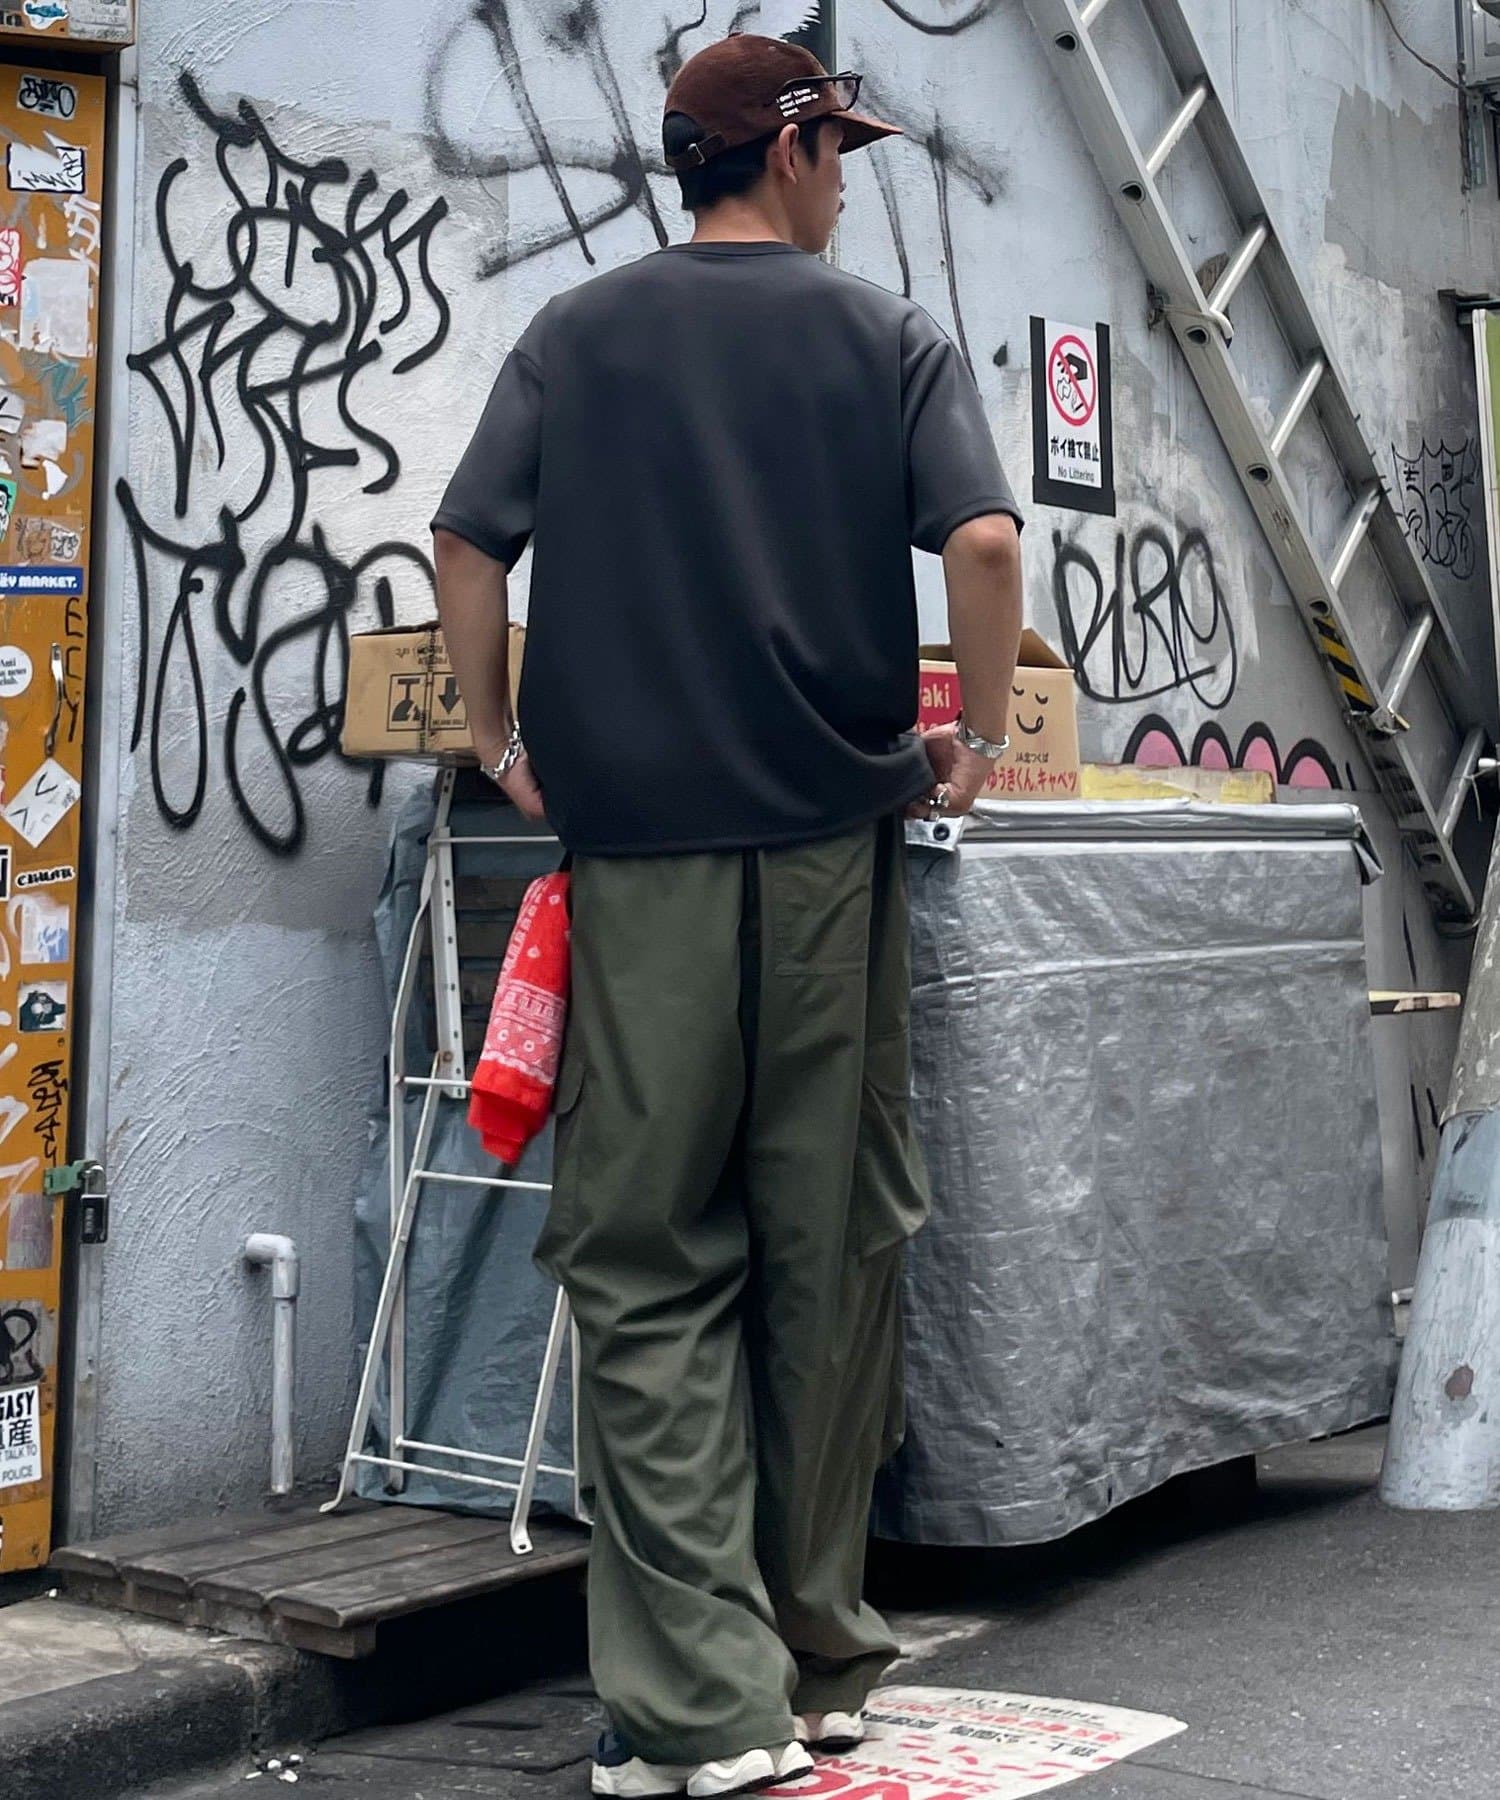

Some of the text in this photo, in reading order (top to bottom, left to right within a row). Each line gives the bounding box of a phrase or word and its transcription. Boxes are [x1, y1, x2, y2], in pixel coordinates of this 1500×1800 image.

[1050, 435, 1099, 462] ポイ捨て禁止
[1057, 465, 1095, 483] No Littering
[18, 575, 78, 588] MARKET.
[2, 1465, 33, 1482] POLICE
